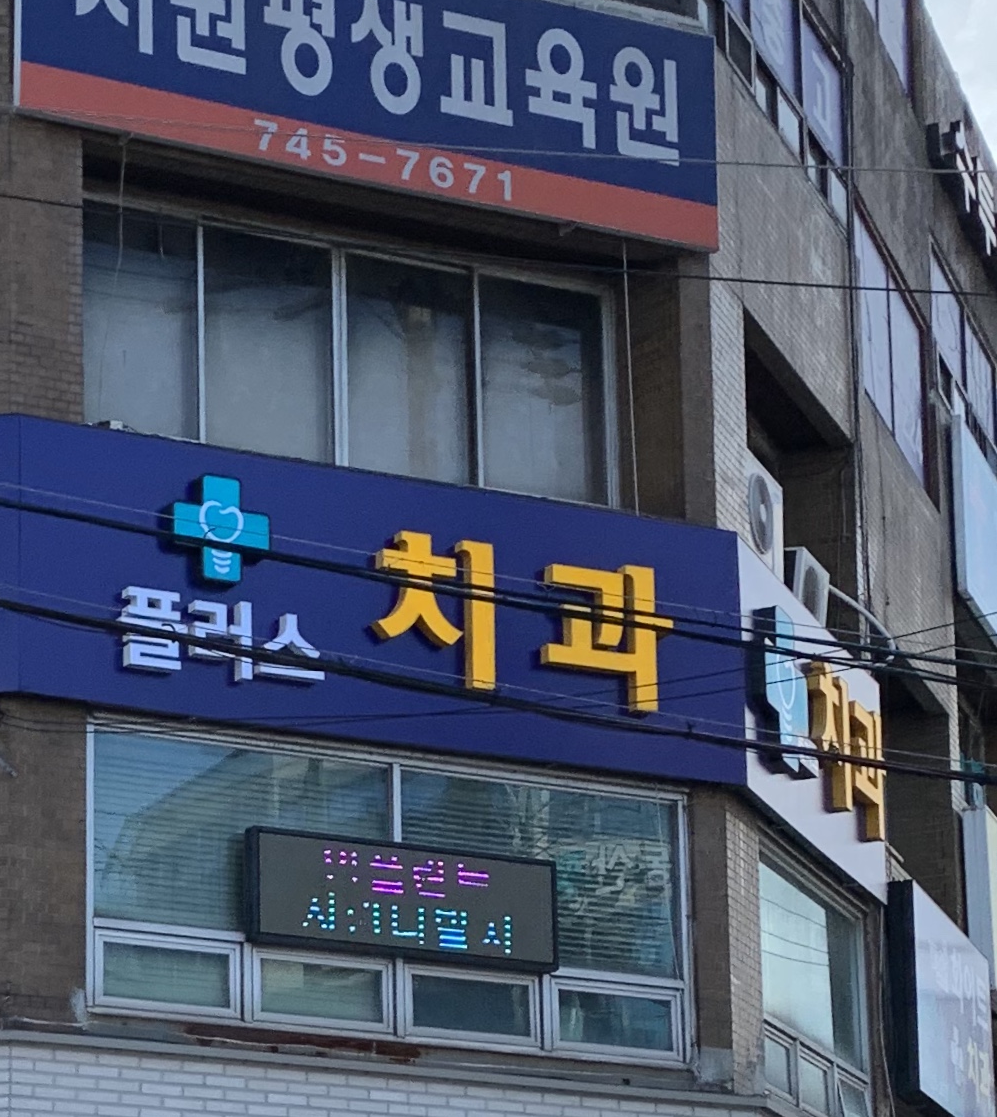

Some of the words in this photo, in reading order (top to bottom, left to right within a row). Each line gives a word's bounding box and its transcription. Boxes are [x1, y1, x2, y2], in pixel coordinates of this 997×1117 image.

[253, 118, 514, 202] 745-7671
[116, 585, 326, 682] 플러스
[371, 530, 674, 714] 치과
